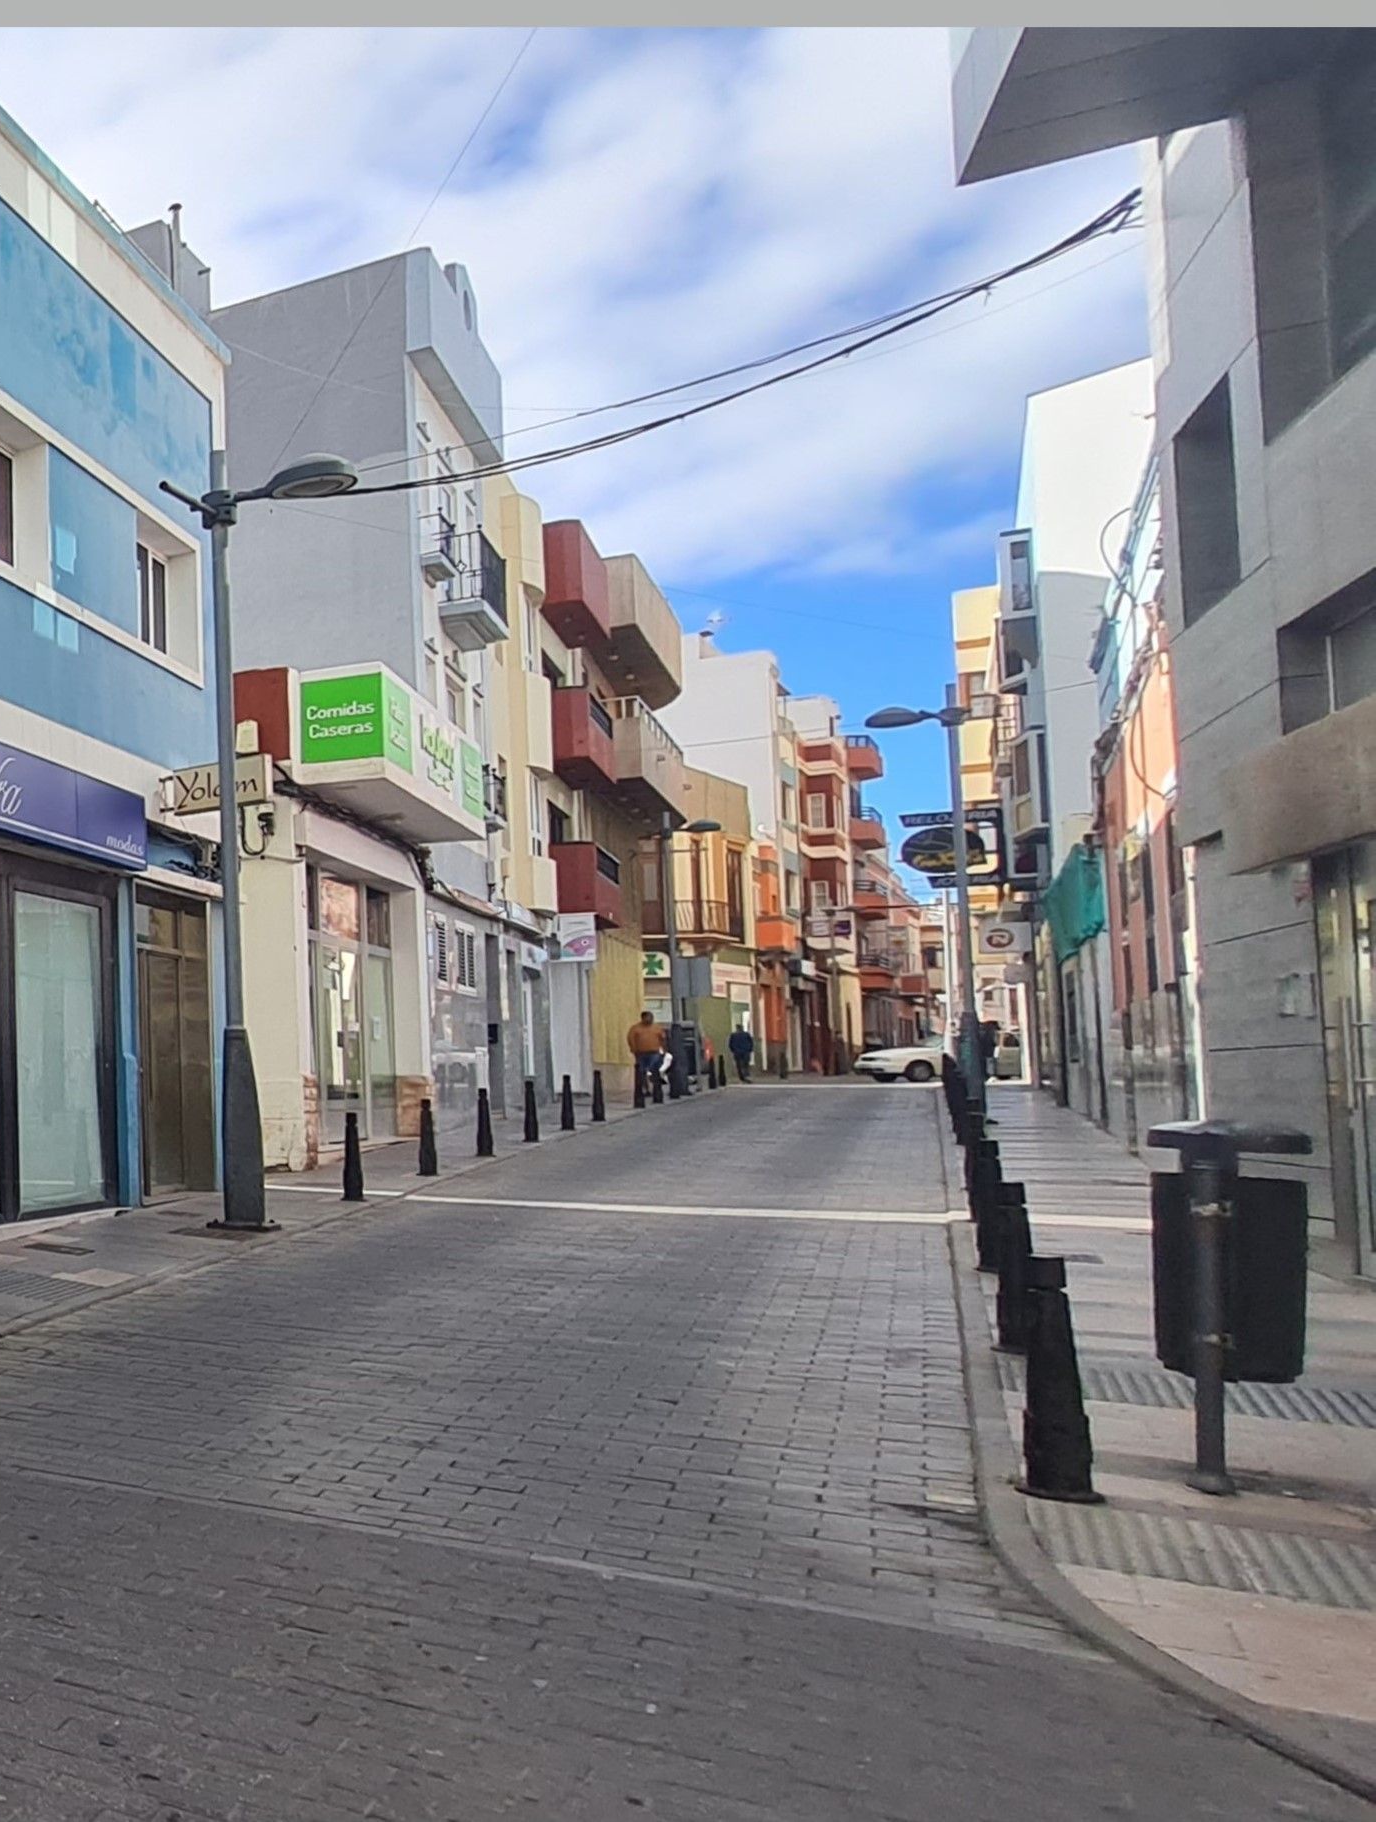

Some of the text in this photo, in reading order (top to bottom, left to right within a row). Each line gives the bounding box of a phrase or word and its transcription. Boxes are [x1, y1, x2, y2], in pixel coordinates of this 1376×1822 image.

[306, 701, 375, 720] Comidas
[309, 721, 374, 739] Caseras
[106, 834, 146, 857] modas
